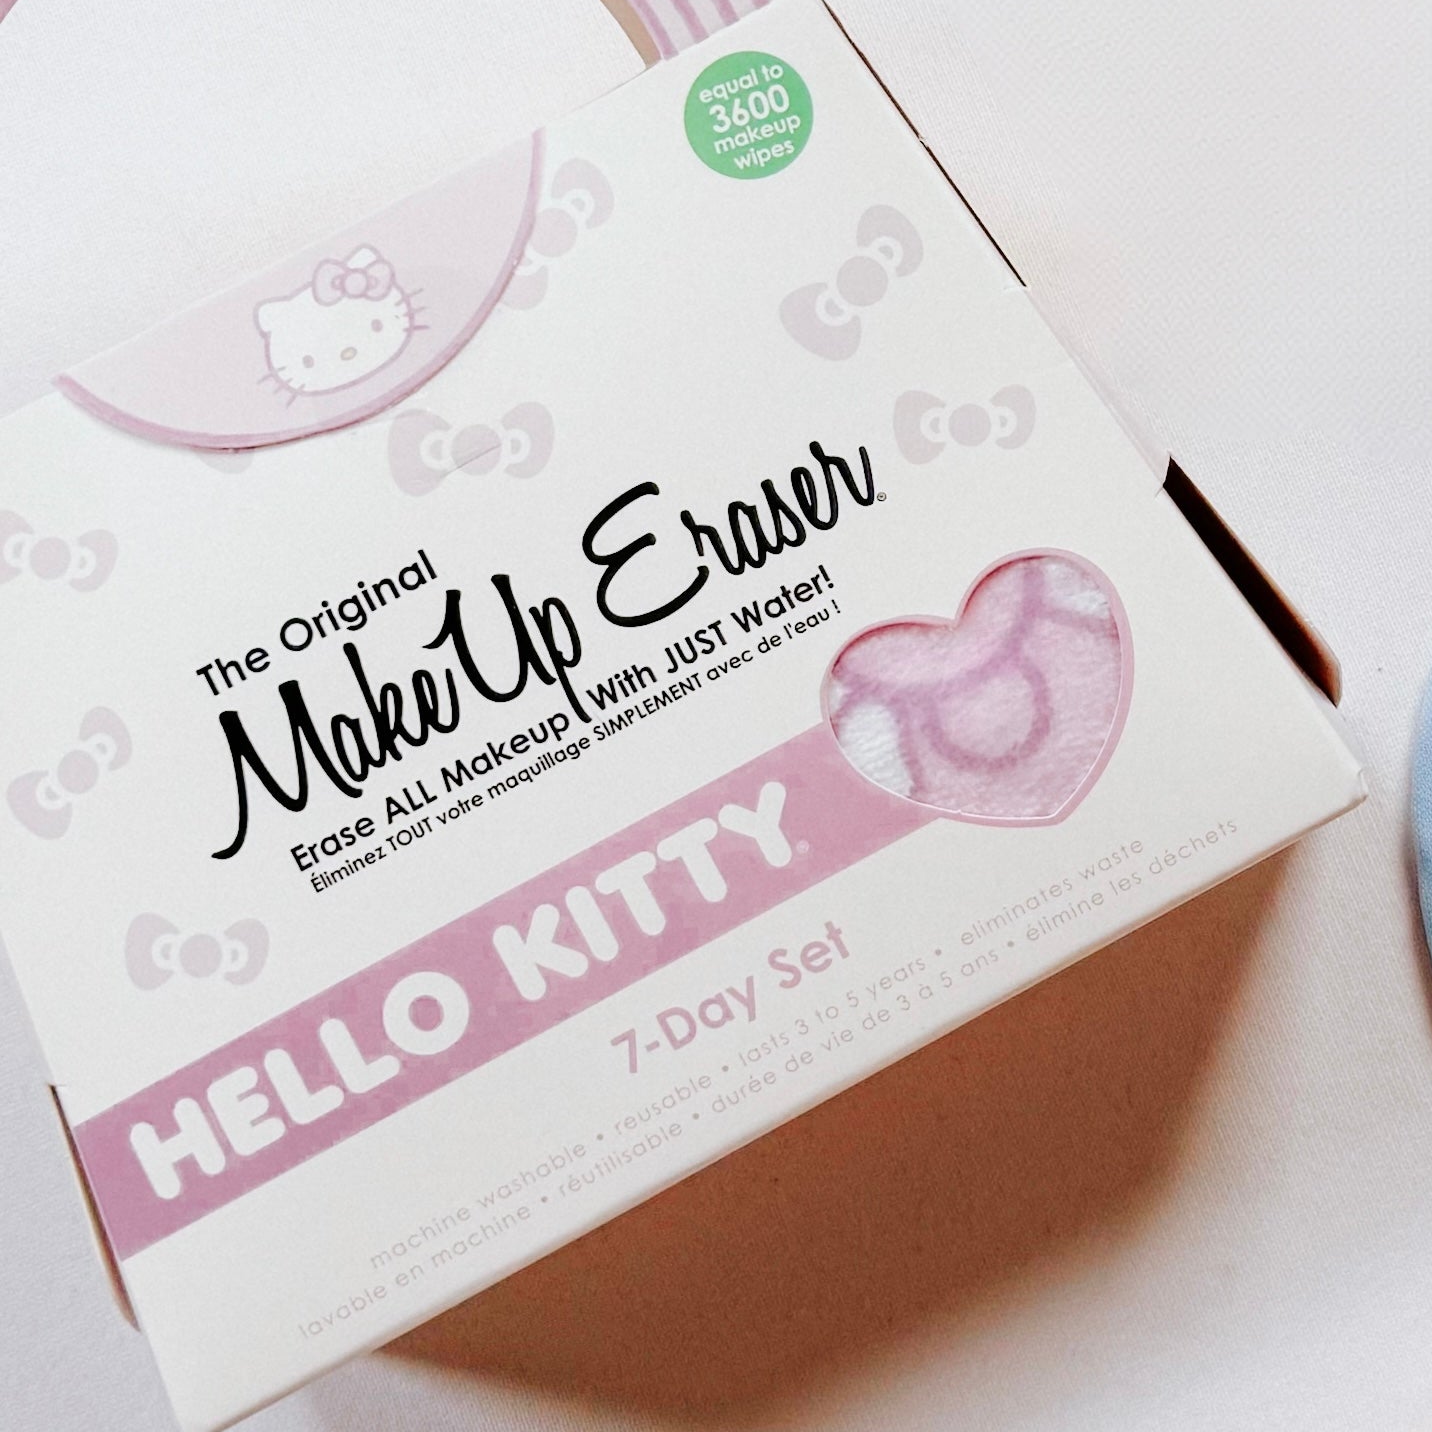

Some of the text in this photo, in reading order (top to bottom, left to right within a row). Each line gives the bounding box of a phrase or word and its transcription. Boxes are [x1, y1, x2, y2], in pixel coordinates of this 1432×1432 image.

[699, 64, 783, 103] equal to
[709, 84, 790, 133] 3600
[714, 115, 801, 154] makeup
[734, 140, 794, 170] wipes
[196, 549, 437, 696] The Original
[290, 564, 835, 871] Erase ALL Makeup With JUST Water!
[310, 846, 387, 893] Éliminez
[386, 818, 435, 852] TOUT
[436, 793, 484, 825] votre
[487, 737, 591, 800] maquillage
[593, 673, 703, 741] SIMPLEMENT
[708, 650, 754, 681] avec
[757, 632, 782, 654] de
[370, 838, 1144, 1270] machine washable reusable lasts 3 to 5 years eliminates waste
[610, 920, 850, 1074] 7-Day Set
[129, 970, 470, 1200] HELLO
[298, 818, 1239, 1339] lavable en machine réutilisable durée de vie de 3 à 5 ans élimine les déchets
